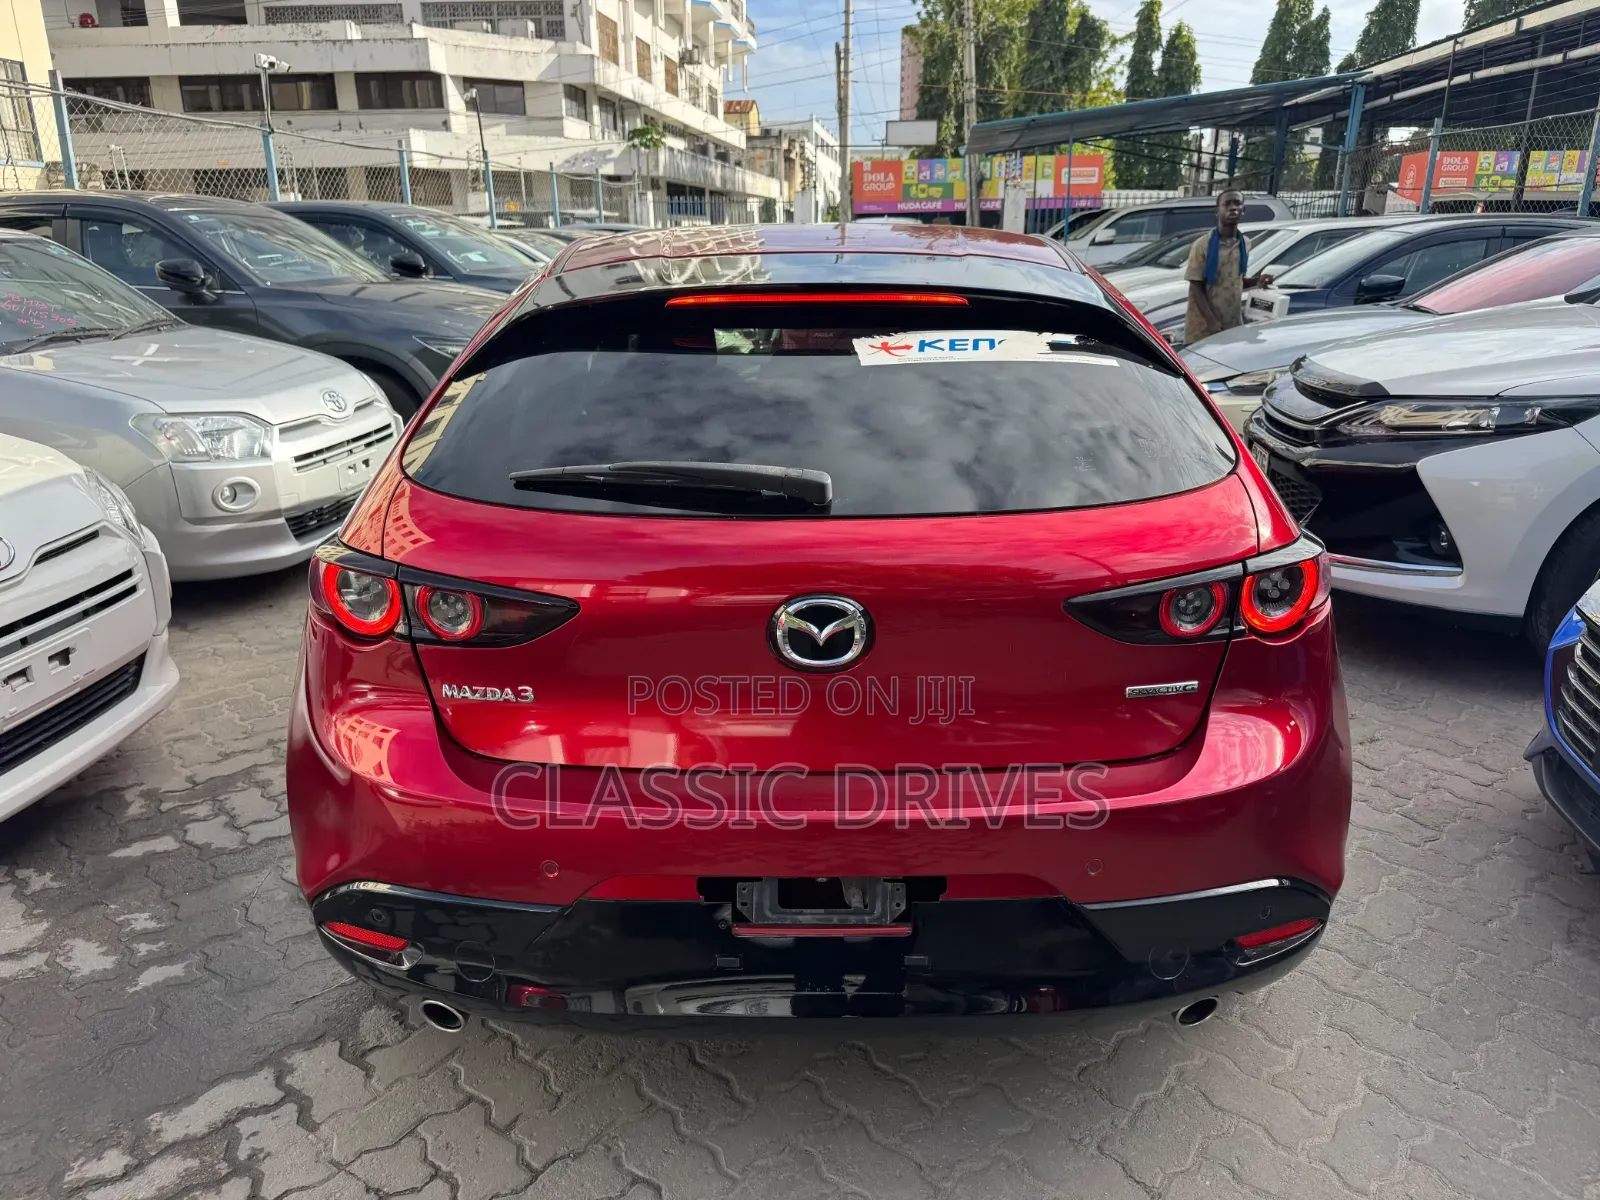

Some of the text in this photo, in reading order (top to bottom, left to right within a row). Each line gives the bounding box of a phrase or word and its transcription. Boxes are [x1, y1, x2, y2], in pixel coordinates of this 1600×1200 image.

[1443, 156, 1469, 165] DOLA
[1441, 164, 1469, 172] GROUP
[863, 172, 895, 183] DOLA
[862, 182, 896, 192] GROUP
[897, 200, 943, 211] HUDA CAFÉ
[918, 338, 1007, 353] KEN
